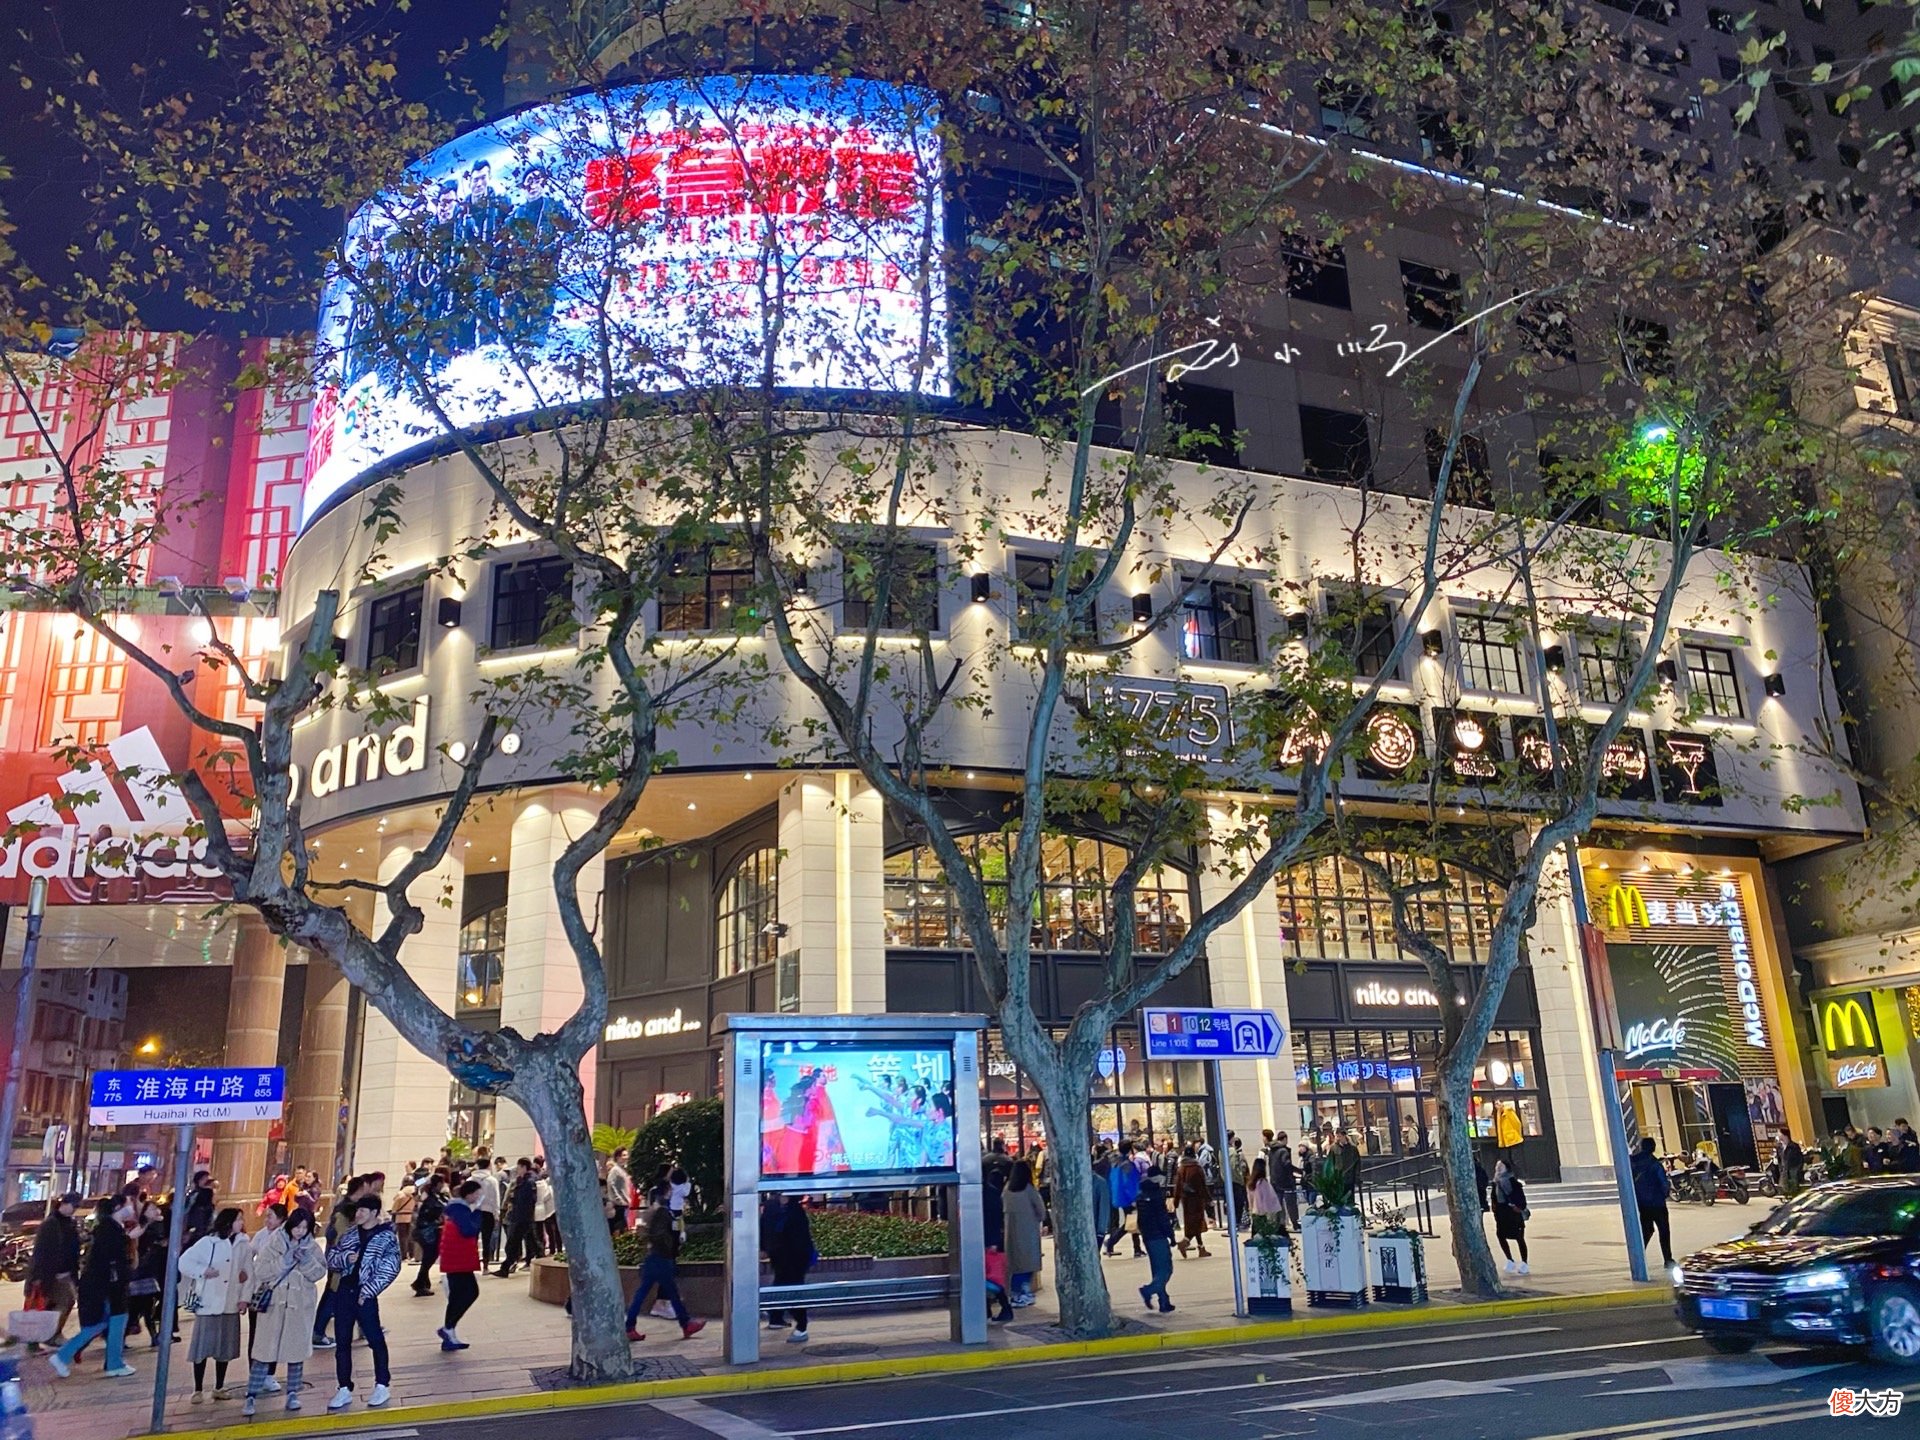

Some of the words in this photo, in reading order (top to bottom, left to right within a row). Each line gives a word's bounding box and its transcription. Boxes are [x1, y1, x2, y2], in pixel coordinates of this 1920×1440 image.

[310, 694, 430, 799] and
[1356, 982, 1401, 1006] niko
[605, 1016, 643, 1042] niko
[644, 1008, 682, 1037] and
[103, 1093, 122, 1102] 775
[254, 1088, 272, 1098] 855
[107, 1078, 121, 1091] 东
[135, 1075, 245, 1101] 淮海中路
[257, 1074, 271, 1087] 西
[106, 1110, 115, 1121] E
[143, 1107, 188, 1120] Huaihai
[255, 1105, 269, 1117] W
